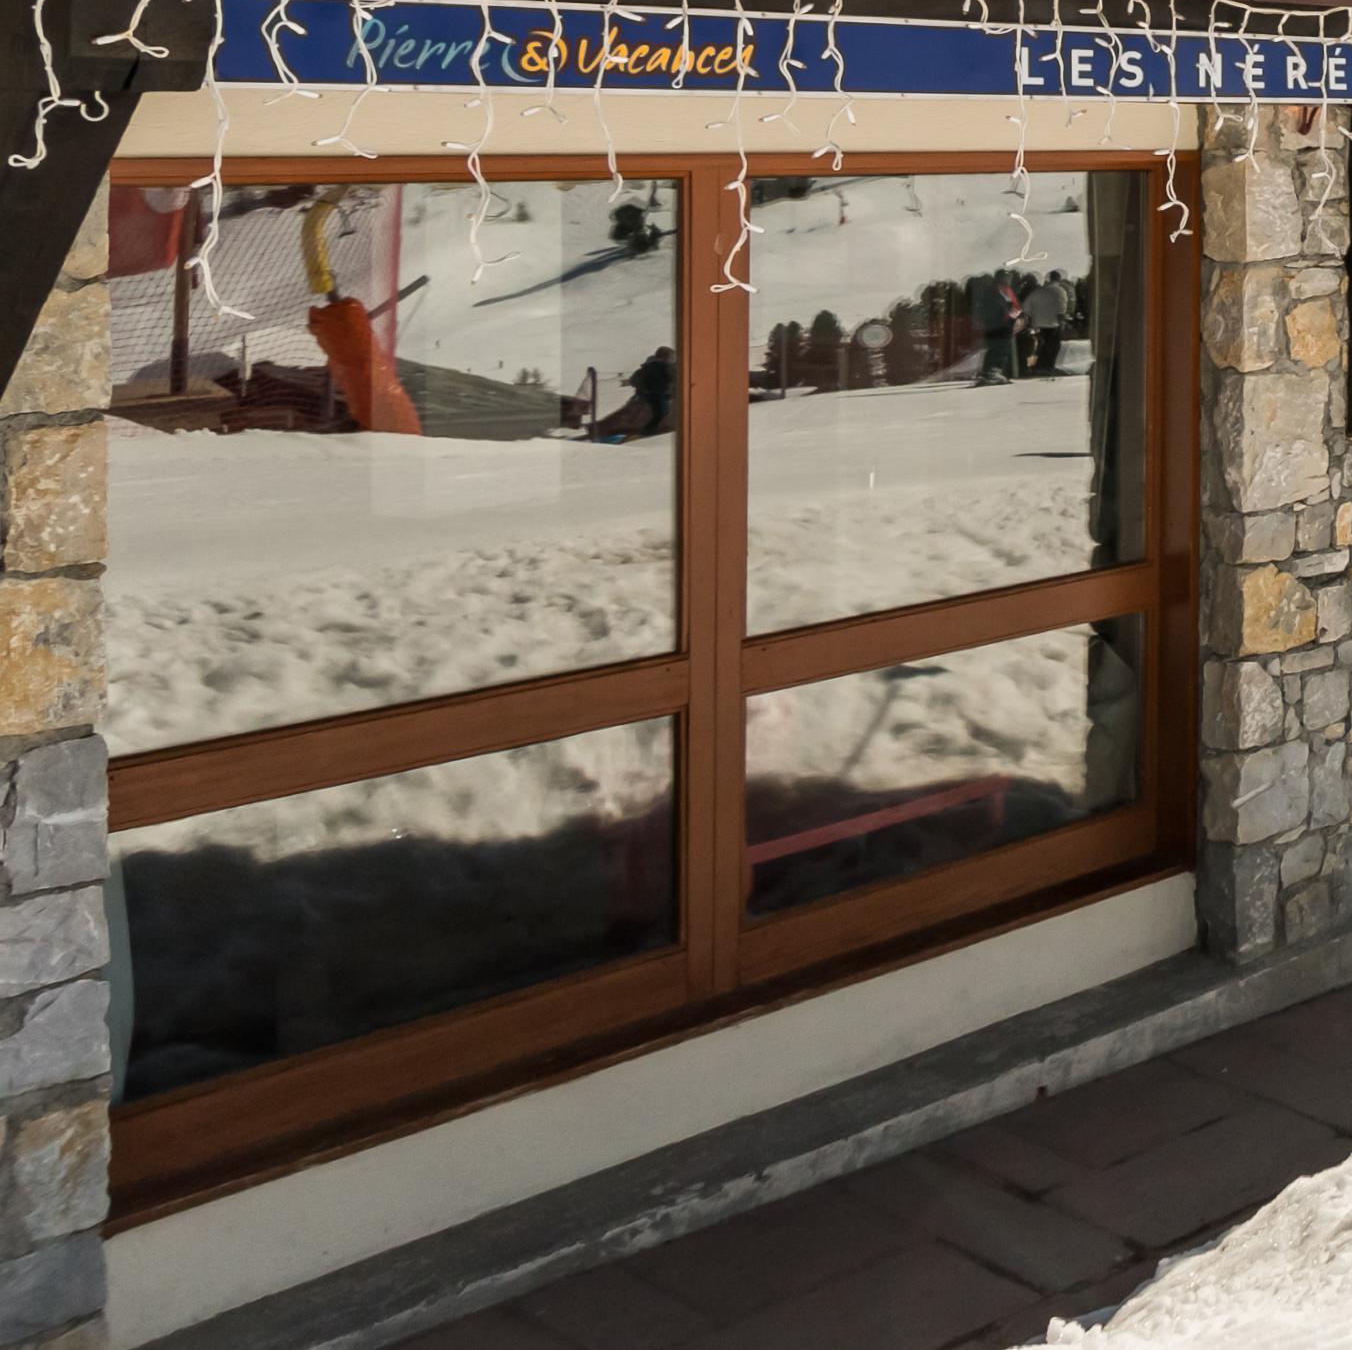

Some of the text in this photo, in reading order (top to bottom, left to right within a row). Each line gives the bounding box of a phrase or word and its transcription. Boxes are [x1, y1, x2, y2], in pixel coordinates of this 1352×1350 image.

[346, 17, 492, 71] Pierre
[577, 26, 755, 74] Vacances
[1020, 46, 1145, 89] LES
